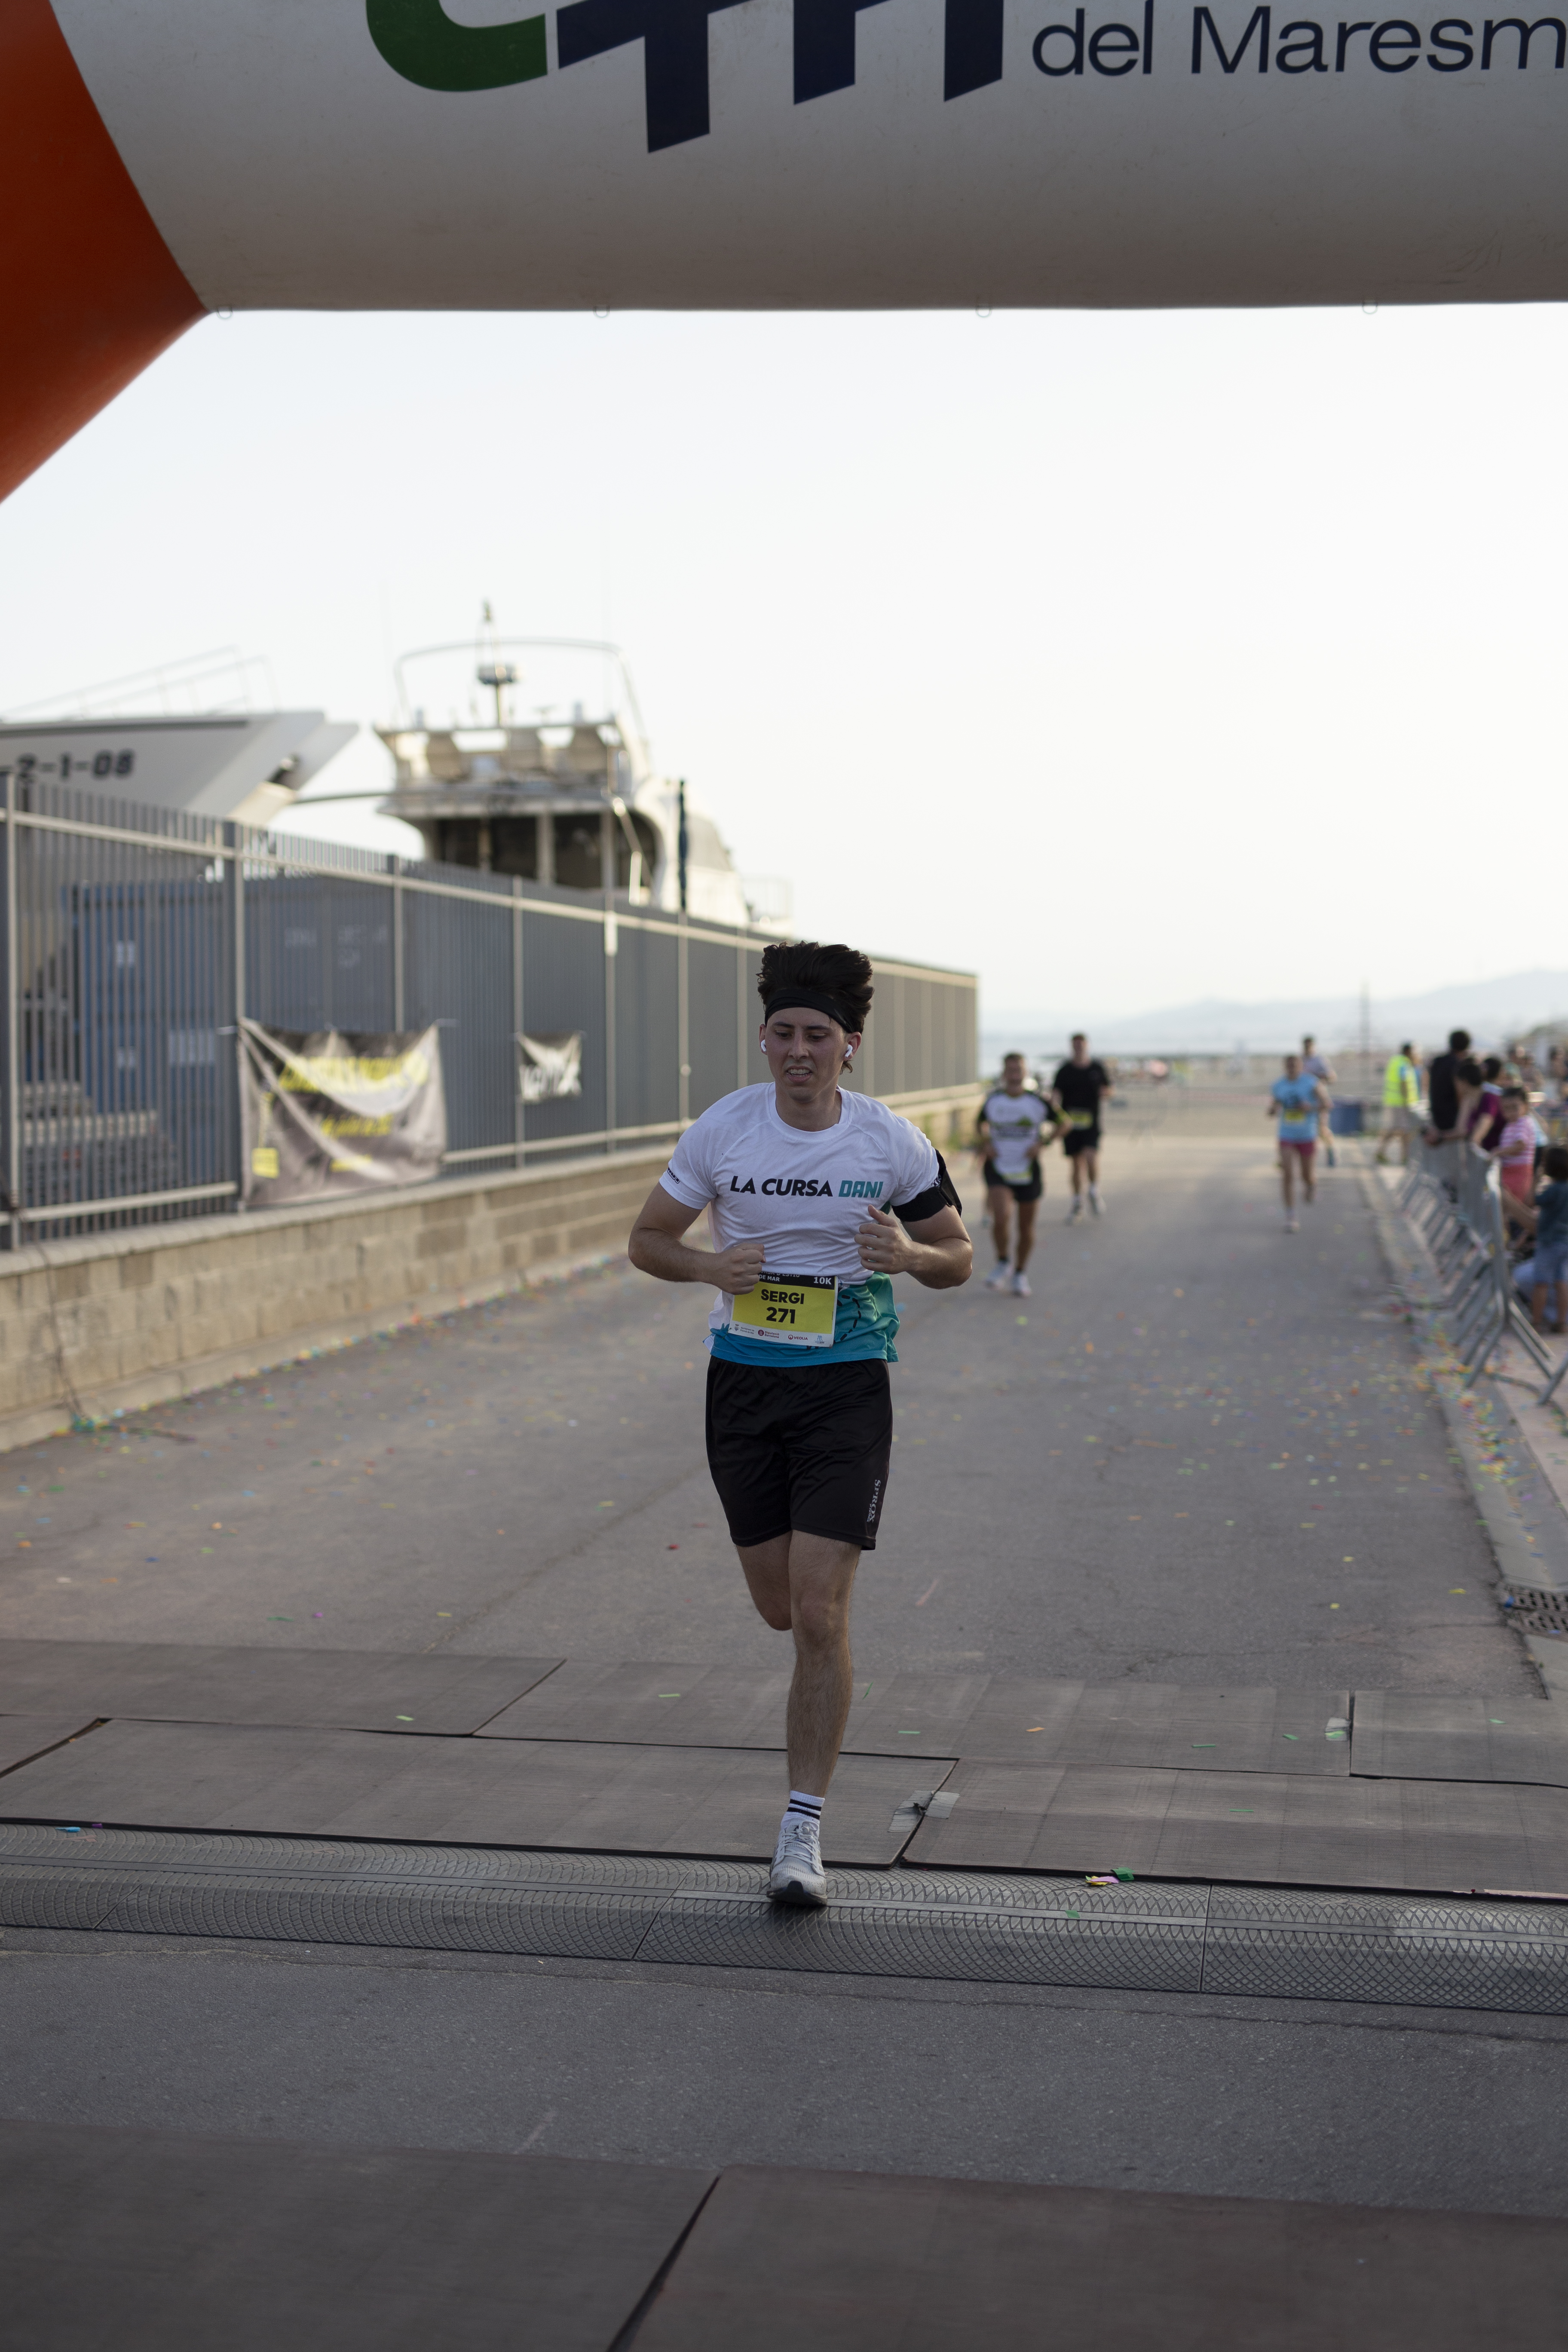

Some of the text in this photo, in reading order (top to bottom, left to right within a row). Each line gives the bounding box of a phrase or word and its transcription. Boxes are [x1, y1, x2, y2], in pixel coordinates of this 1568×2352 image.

[1032, 0, 1154, 77] del
[1191, 5, 1567, 74] Maresm
[730, 1175, 884, 1198] LA CURSA DANI
[814, 1277, 832, 1285] 10K
[761, 1289, 805, 1305] SERGI
[766, 1306, 796, 1324] 271
[868, 1479, 881, 1523] SPROX
